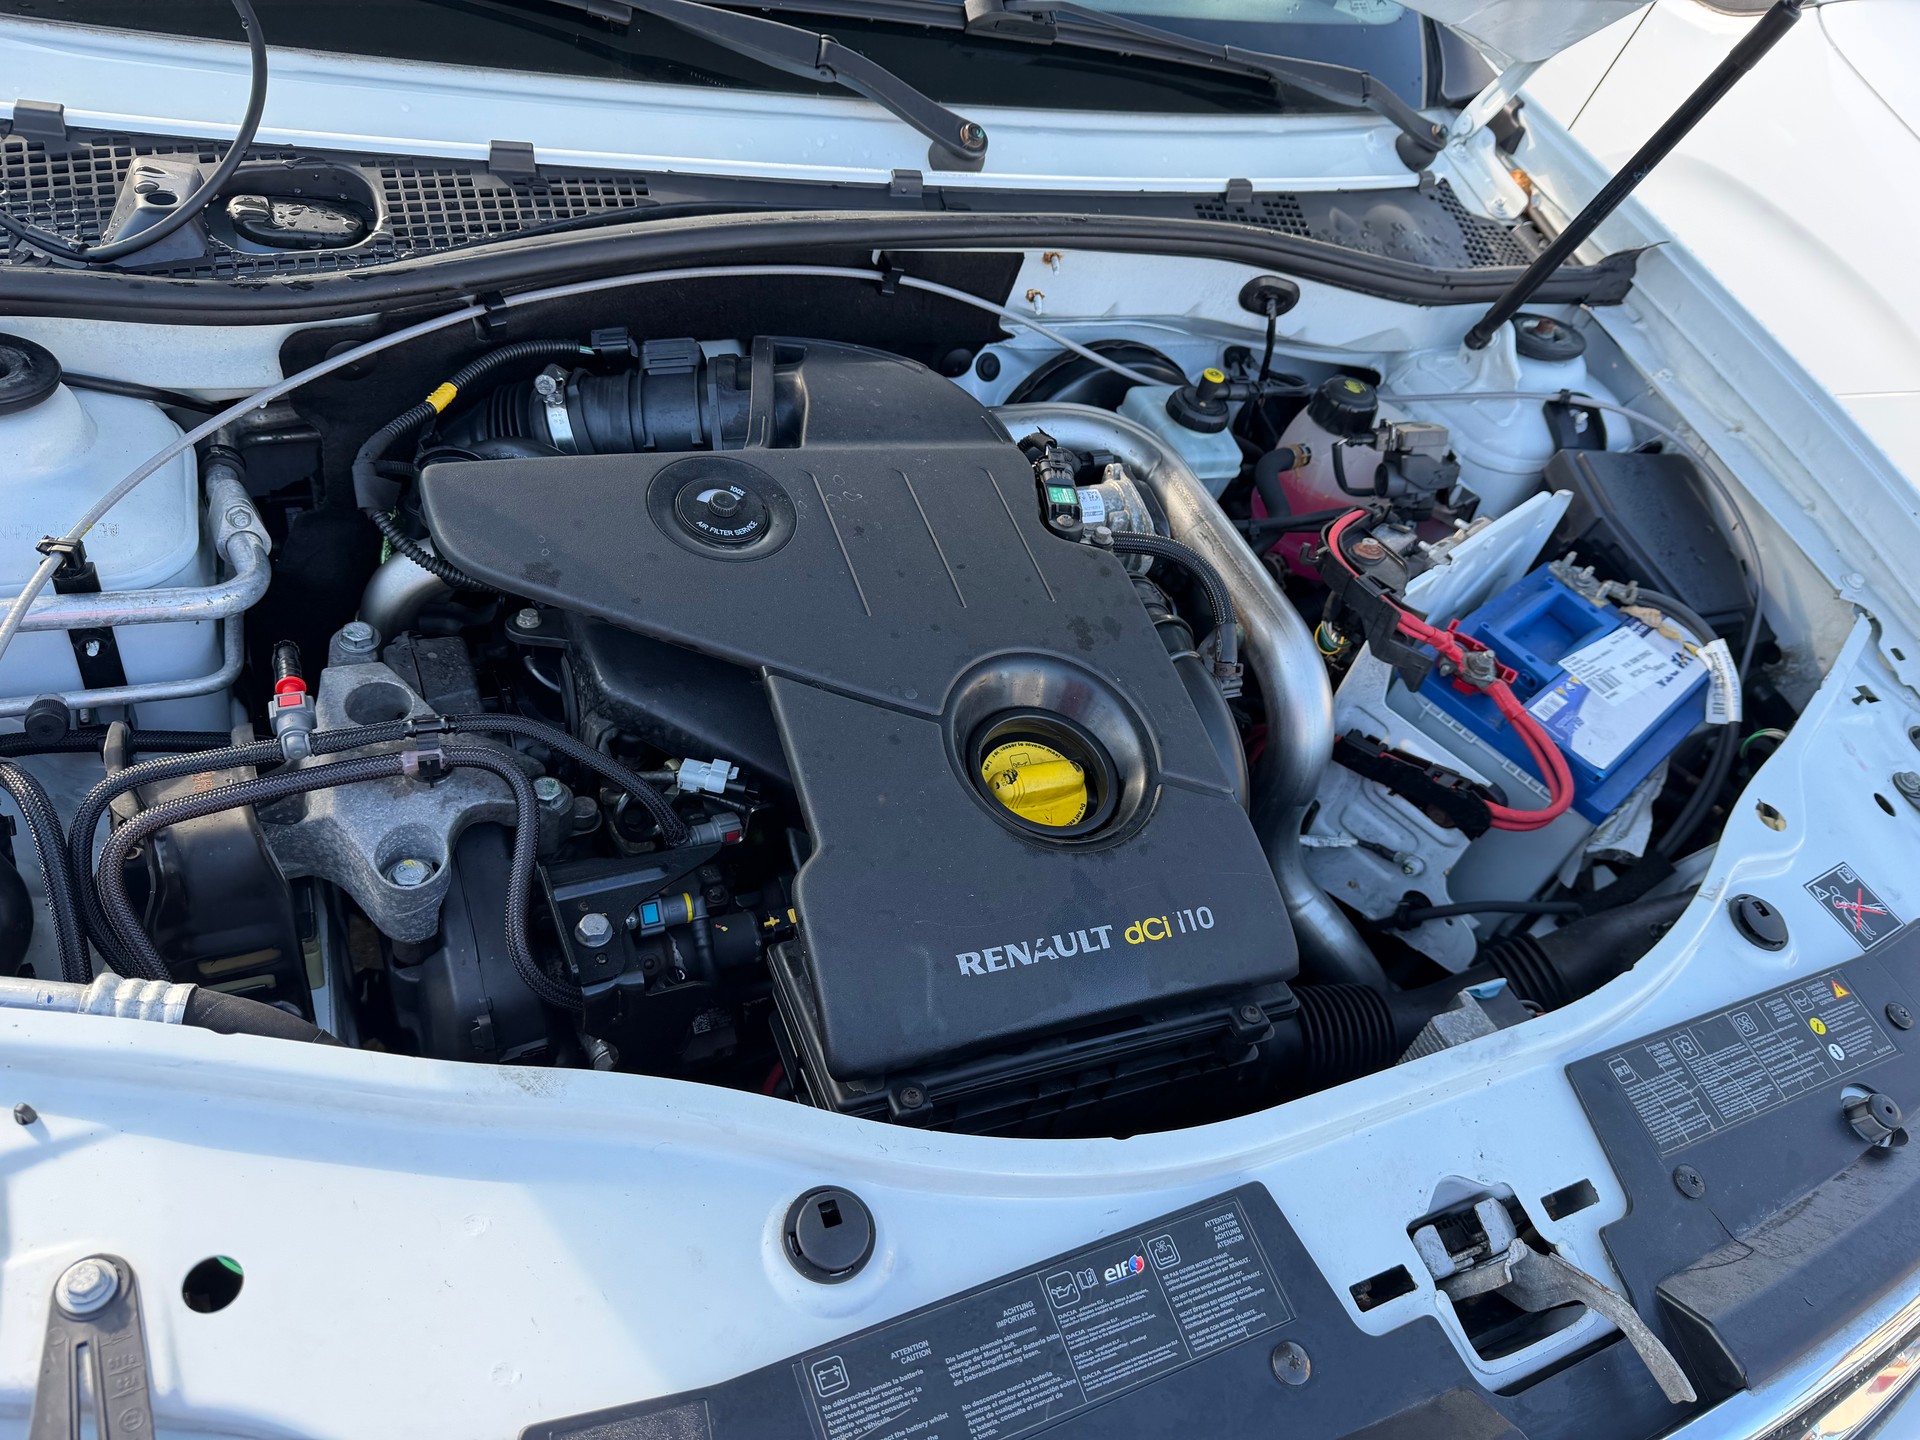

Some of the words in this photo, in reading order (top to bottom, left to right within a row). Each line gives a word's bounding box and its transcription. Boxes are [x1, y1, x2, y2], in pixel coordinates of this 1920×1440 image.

[696, 521, 709, 530] AIR
[710, 527, 734, 536] FILTER
[734, 520, 758, 536] SERVICE
[956, 924, 1112, 977] RENAULT
[1124, 915, 1172, 945] dCi
[1205, 1212, 1234, 1228] ATTENTION
[1213, 1219, 1238, 1233] CAUTION
[1215, 1227, 1241, 1241] ACHTUNG
[1104, 1261, 1129, 1281] elf
[996, 1308, 1037, 1328] IMPORTANTE
[1003, 1301, 1033, 1317] ACHTUNG
[1058, 1309, 1077, 1320] DACIA
[956, 1348, 979, 1360] batterie
[980, 1339, 1003, 1351] niemals
[1004, 1326, 1037, 1342] abklemmen
[1066, 1329, 1085, 1340] DACIA
[891, 1340, 929, 1359] ATTENTION
[901, 1348, 932, 1364] CAUTION
[948, 1359, 972, 1372] solange
[973, 1354, 982, 1362] der
[983, 1347, 1001, 1358] Motor
[950, 1371, 961, 1379] Vor
[962, 1364, 981, 1376] jedem
[981, 1354, 1004, 1367] Eingriff
[1012, 1347, 1022, 1355] der
[1023, 1339, 1046, 1351] Batterie
[1046, 1333, 1060, 1342] bitte
[1074, 1350, 1093, 1360] DACIA
[964, 1356, 1023, 1382] Gebrauchsanleitung
[1023, 1350, 1041, 1359] lesen.
[1082, 1370, 1102, 1381] DACIA
[833, 1390, 870, 1408] débranchez
[870, 1381, 892, 1394] jamais
[899, 1369, 924, 1382] batterie
[965, 1405, 991, 1419] mientras
[998, 1394, 1016, 1405] motor
[1039, 1377, 1062, 1389] marcha.
[972, 1390, 1006, 1407] desconecte
[1007, 1383, 1025, 1393] nunca
[824, 1406, 849, 1419] lorsque
[858, 1394, 880, 1407] moteur
[881, 1386, 904, 1397] tourne.
[828, 1416, 847, 1427] Avant
[847, 1409, 864, 1419] toute
[865, 1394, 903, 1412] intervention
[968, 1416, 985, 1426] Antes
[995, 1400, 1022, 1415] cualquier
[1059, 1379, 1076, 1389] sobre
[1000, 1408, 1026, 1421] consulte
[1033, 1395, 1055, 1408] manual
[829, 1422, 854, 1435] batterie
[855, 1412, 880, 1425] veuillez
[881, 1399, 910, 1415] consulter
[894, 1430, 905, 1438] the
[906, 1421, 928, 1434] battery
[929, 1412, 949, 1424] whilst
[978, 1429, 998, 1439] bordo.
